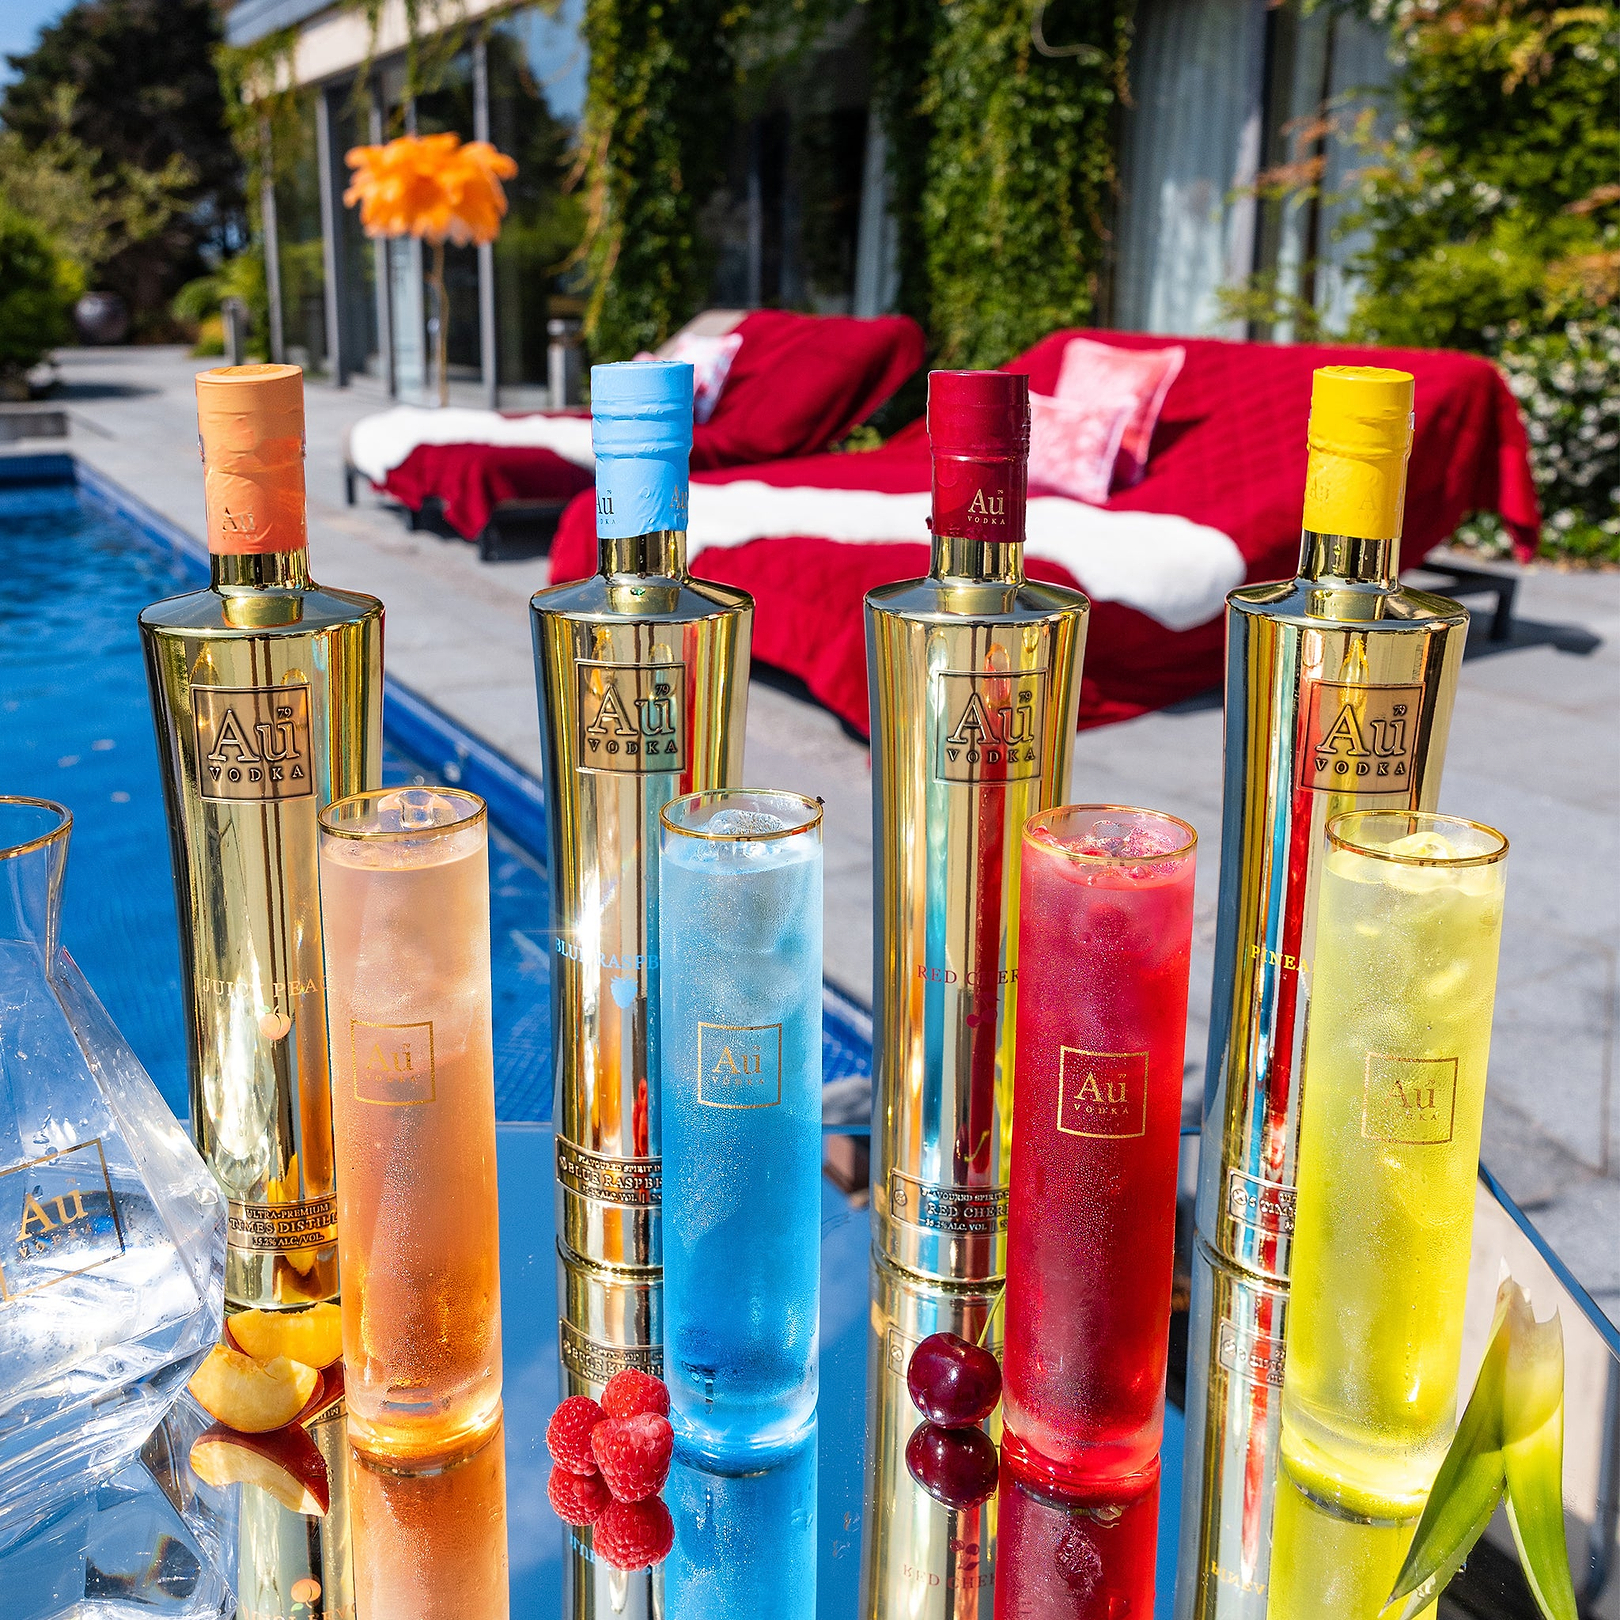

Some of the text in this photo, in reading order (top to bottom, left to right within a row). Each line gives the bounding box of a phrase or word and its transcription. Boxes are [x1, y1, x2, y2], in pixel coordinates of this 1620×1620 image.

[968, 488, 1005, 515] Au
[967, 515, 1006, 525] VODKA
[655, 683, 671, 696] 79
[1018, 690, 1033, 703] 79
[277, 707, 293, 719] 79
[586, 682, 676, 736] Au
[946, 692, 1035, 746] Au
[207, 708, 300, 762] Au
[1315, 703, 1406, 758] Au
[587, 738, 678, 755] VODKA
[946, 748, 1036, 764] VODKA
[208, 765, 304, 782] VODKA
[1314, 757, 1406, 776] VODKA
[917, 965, 957, 984] RED
[366, 1043, 414, 1072] Au
[711, 1045, 763, 1075] Au
[1074, 1071, 1128, 1103] Au
[1381, 1078, 1436, 1110] Au
[1073, 1103, 1129, 1115] VODKA
[568, 1161, 600, 1185] BLUE
[15, 1188, 89, 1243] Au
[246, 1202, 330, 1220] ULTRA-PREMIUM
[927, 1202, 958, 1217] RED
[229, 1217, 275, 1234] TIMES
